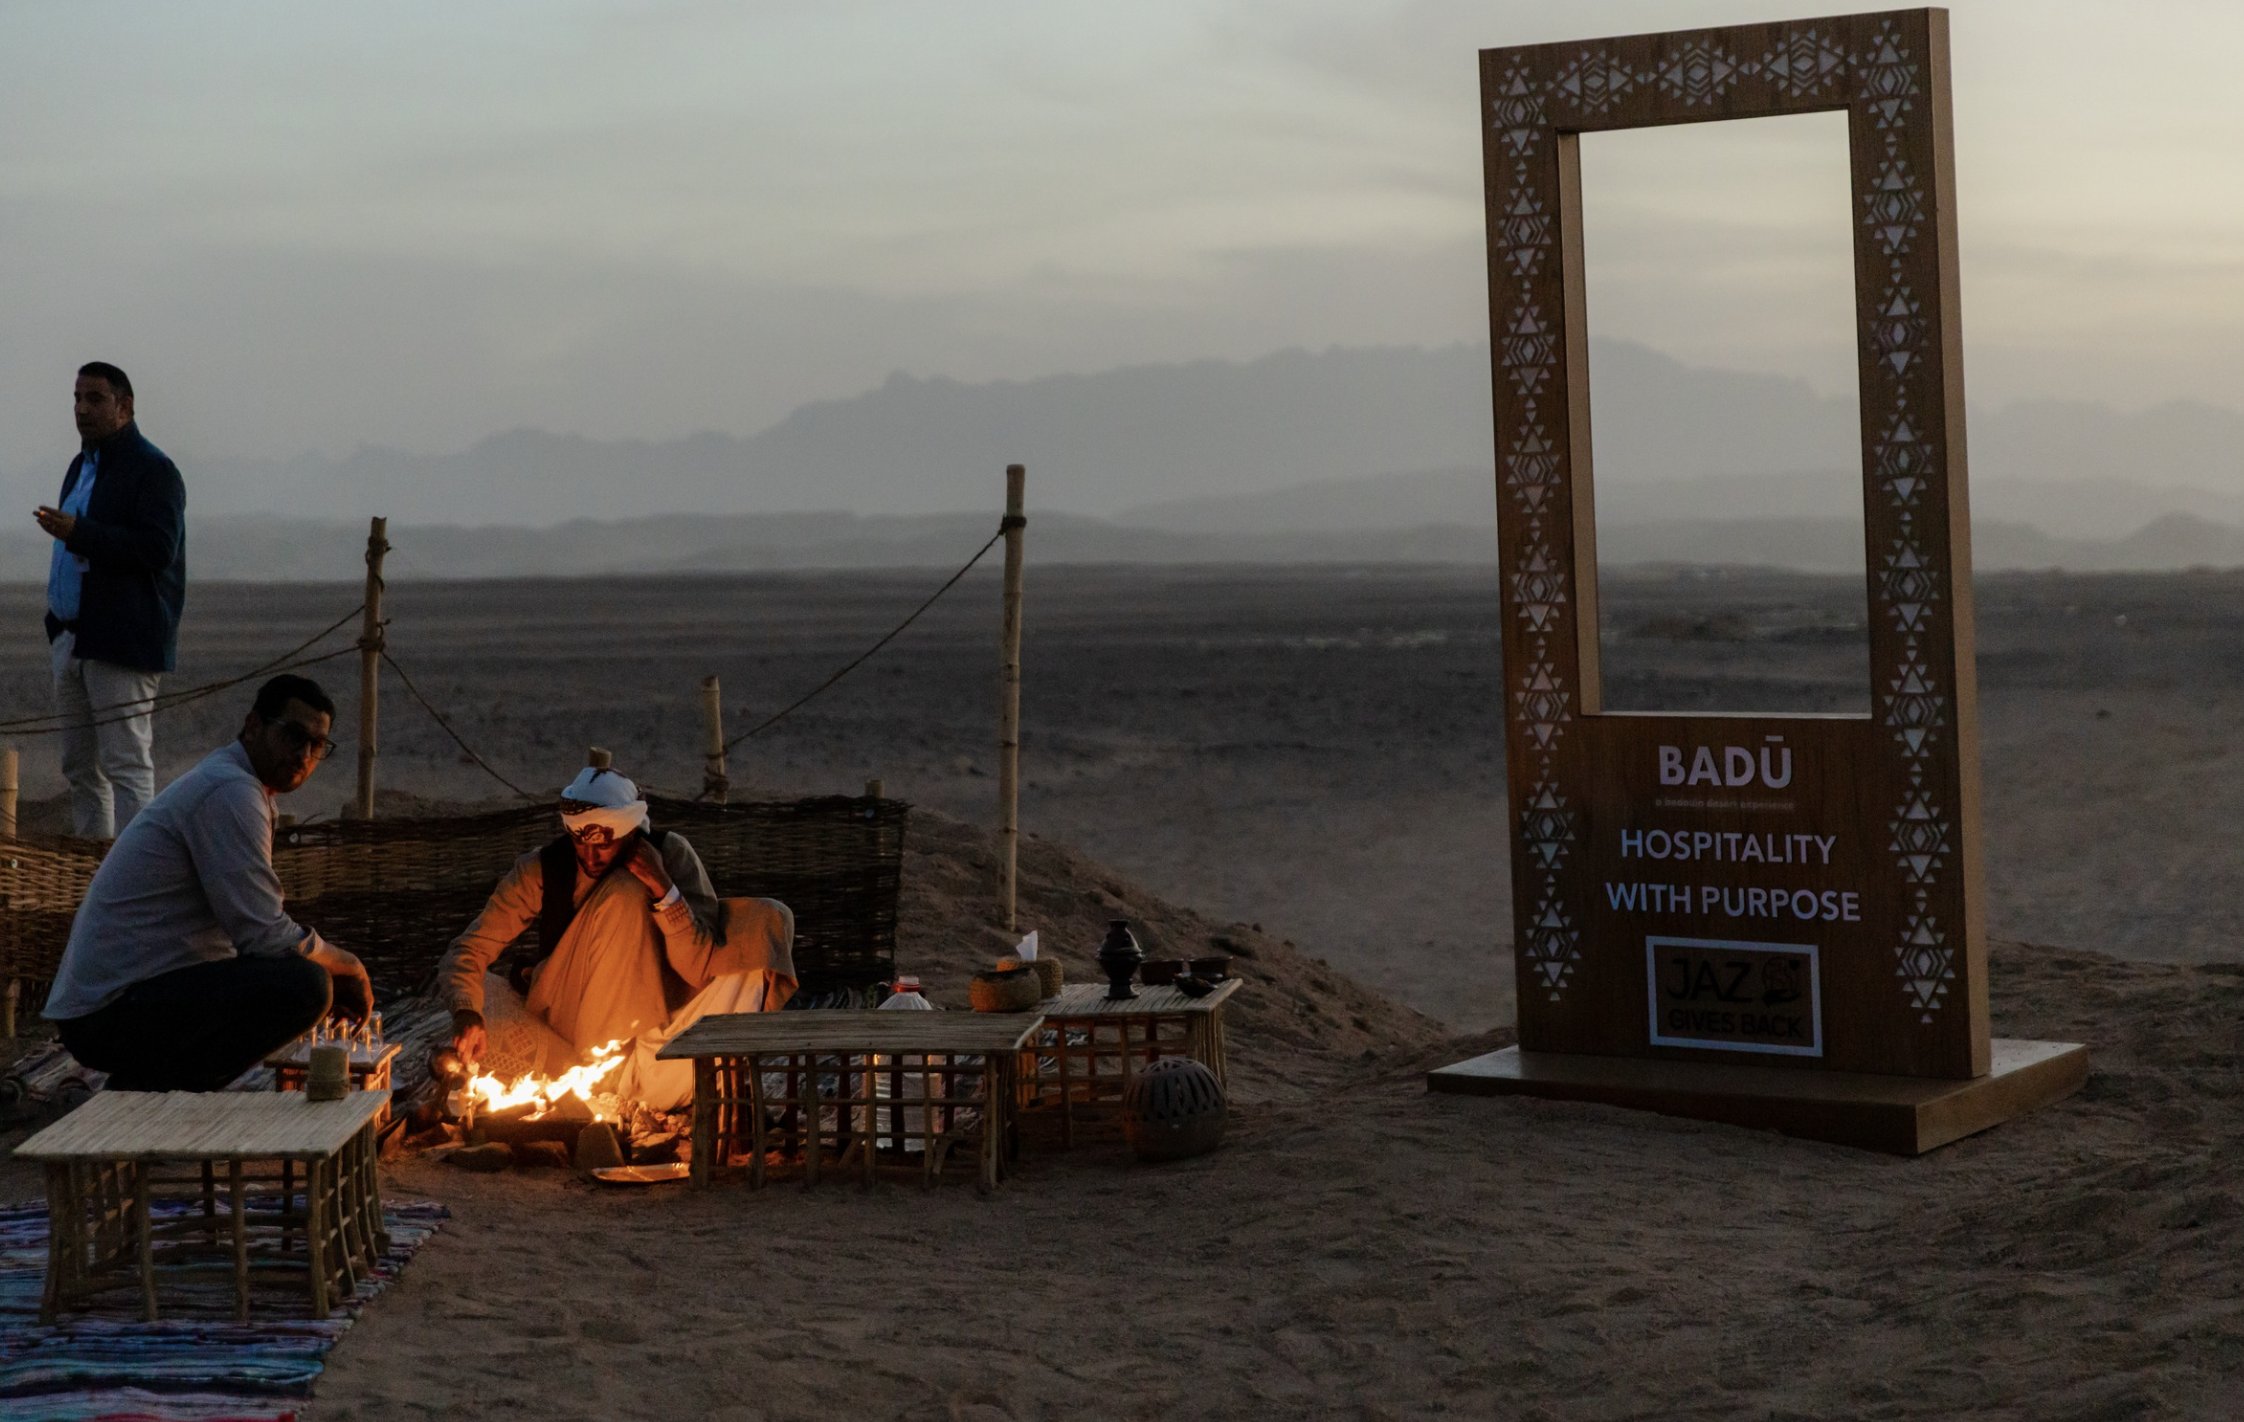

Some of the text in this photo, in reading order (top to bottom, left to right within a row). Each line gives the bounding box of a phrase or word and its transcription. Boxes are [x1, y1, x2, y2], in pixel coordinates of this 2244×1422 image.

[1658, 735, 1792, 789] BADŪ
[1621, 829, 1836, 864] HOSPITALITY
[1606, 882, 1861, 921] WITH PURPOSE
[1667, 958, 1752, 1003] JAZ
[1668, 1008, 1802, 1038] GIVES BACK
